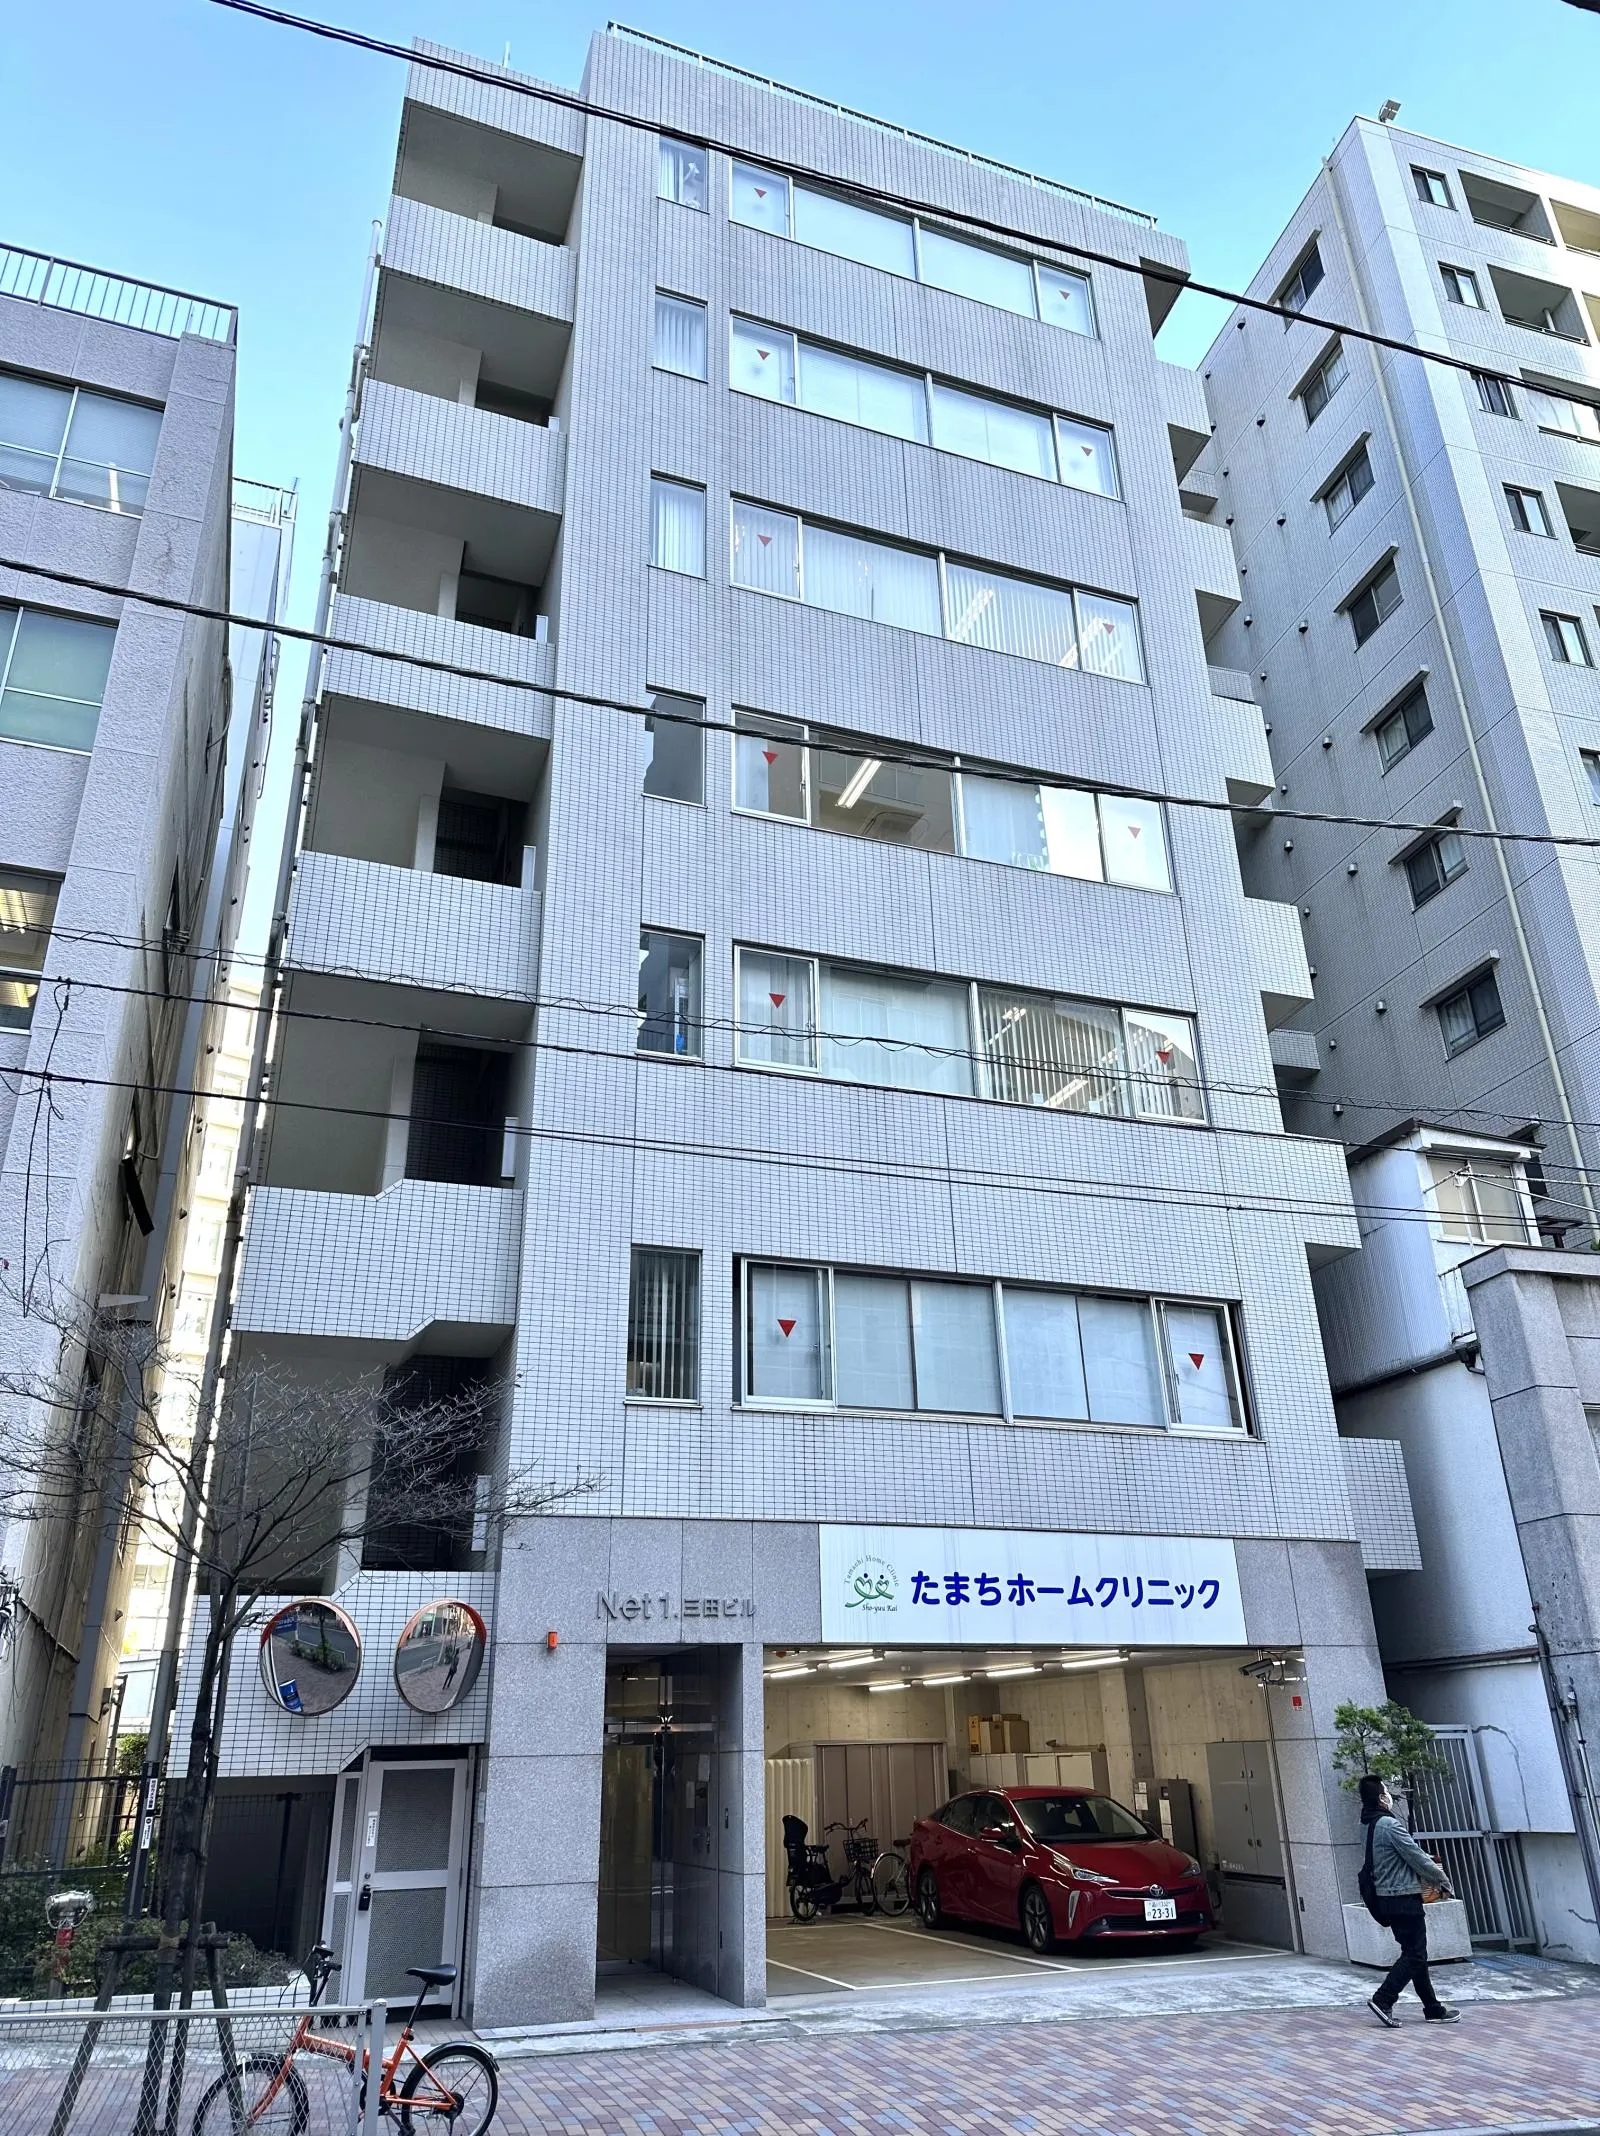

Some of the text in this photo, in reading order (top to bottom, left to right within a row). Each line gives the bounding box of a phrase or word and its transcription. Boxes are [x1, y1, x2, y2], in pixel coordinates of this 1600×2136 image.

[865, 1554, 886, 1566] Home
[887, 1564, 899, 1587] Clinic
[910, 1570, 1220, 1609] たまちホームクリニック
[886, 1604, 898, 1612] Kai
